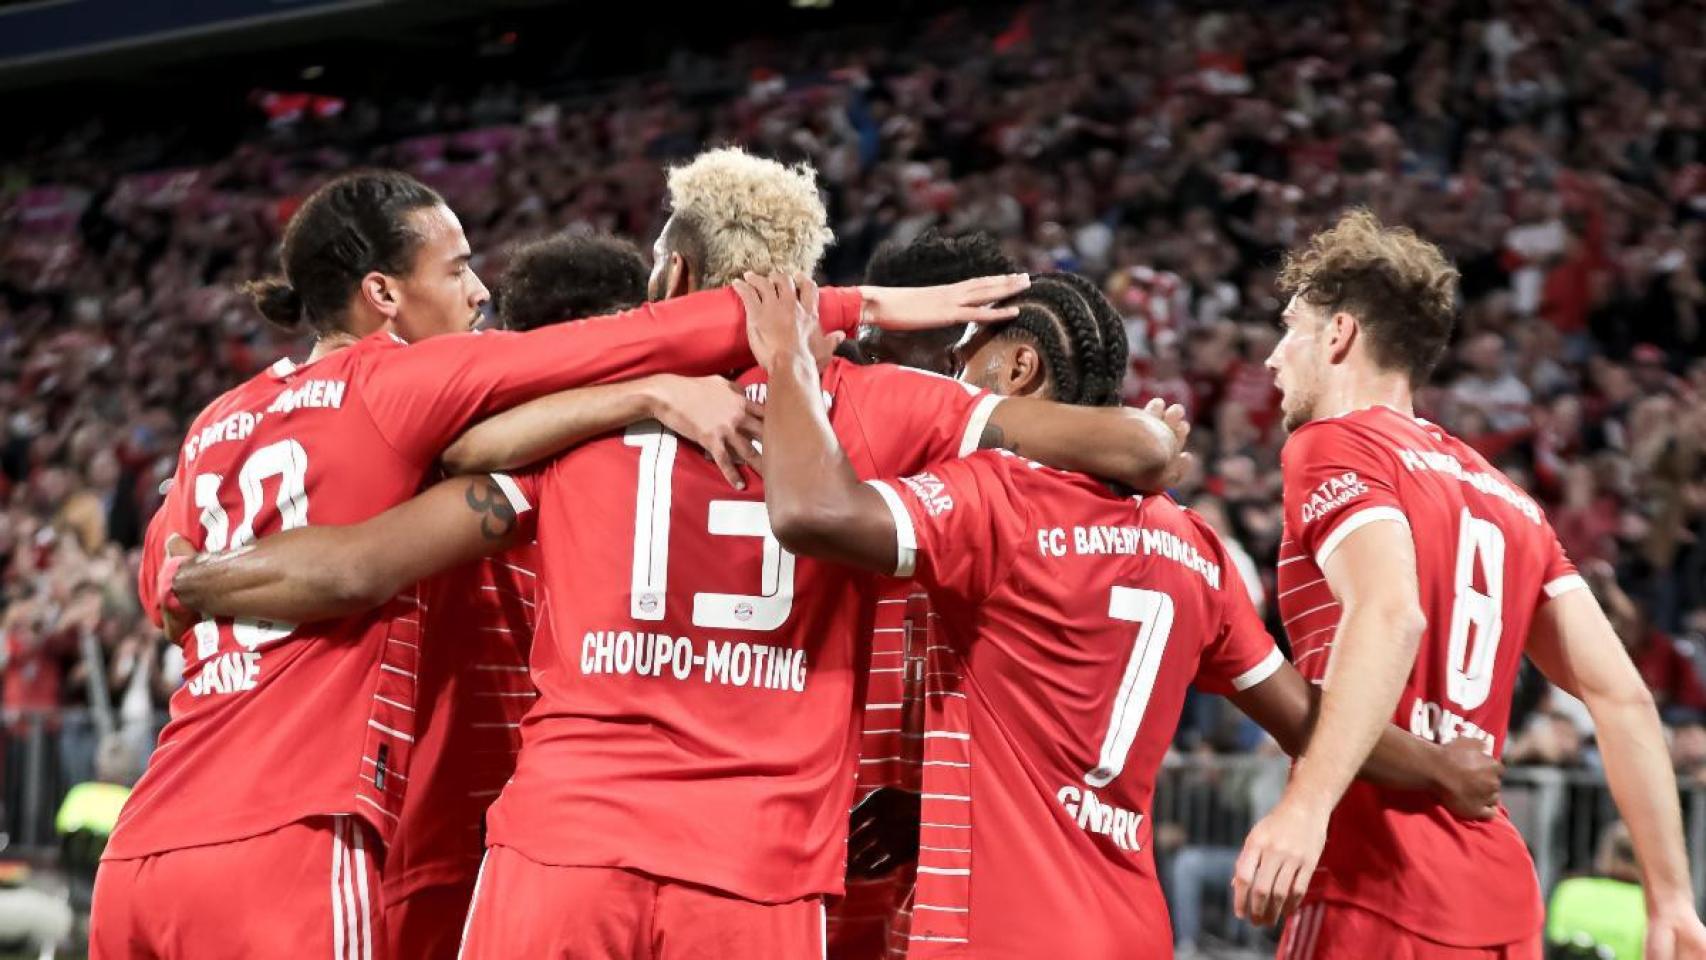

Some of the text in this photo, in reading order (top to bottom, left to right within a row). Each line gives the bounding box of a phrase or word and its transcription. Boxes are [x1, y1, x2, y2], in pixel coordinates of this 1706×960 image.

[1301, 471, 1358, 523] QATAR
[1037, 527, 1067, 557] FC
[1446, 506, 1506, 711] 8
[580, 631, 808, 692] CHOUPO-MOTING
[1084, 585, 1175, 788] 7
